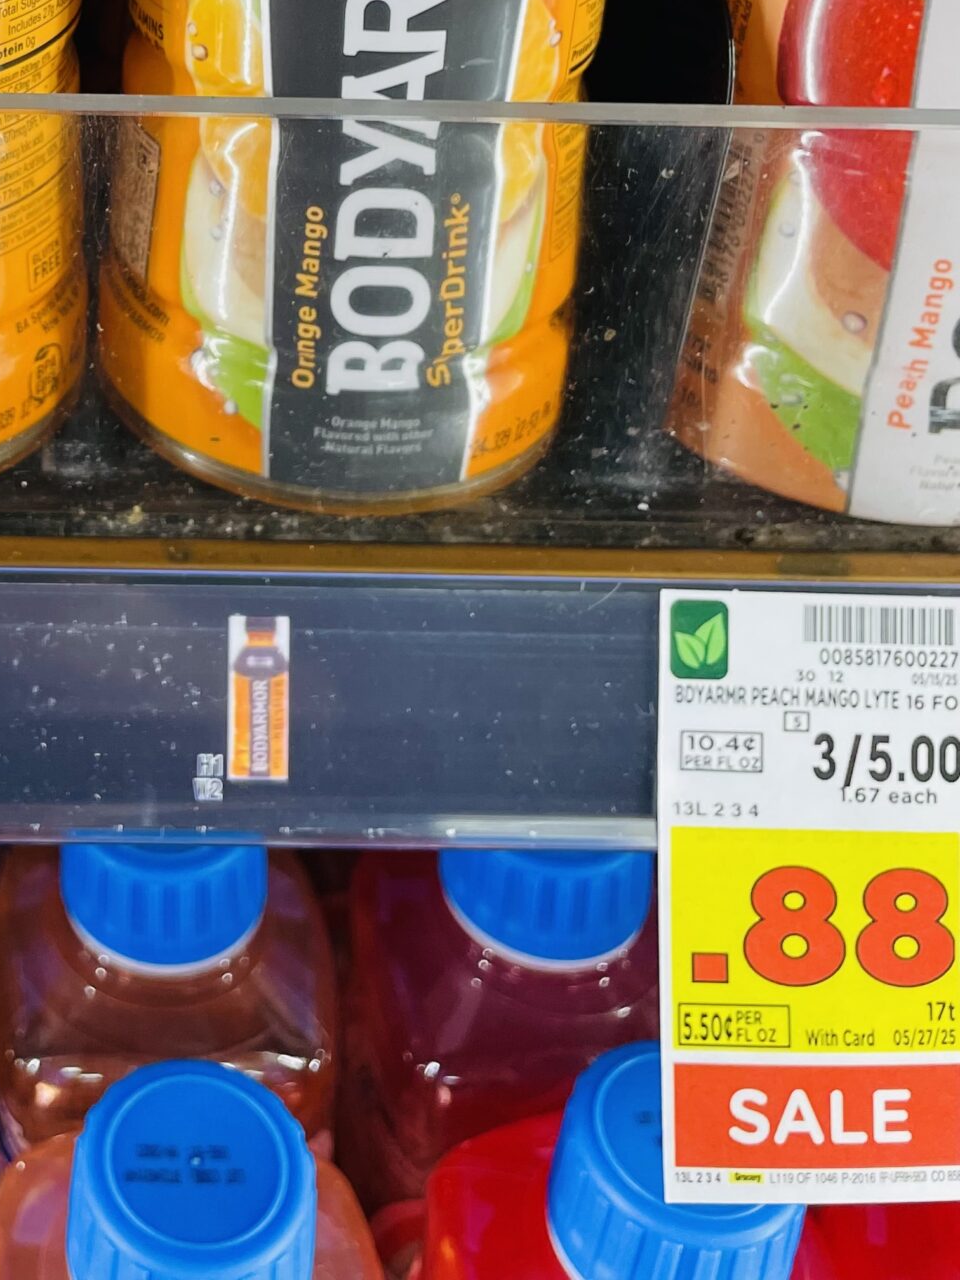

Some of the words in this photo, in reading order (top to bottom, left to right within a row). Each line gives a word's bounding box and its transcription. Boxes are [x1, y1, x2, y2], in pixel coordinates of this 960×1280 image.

[7, 13, 42, 36] Includes
[295, 204, 328, 298] Mango
[908, 257, 955, 350] Mango
[820, 648, 959, 669] 0085817600227
[796, 670, 815, 682] 30
[829, 670, 844, 683] 12
[675, 684, 747, 705] BDYARMR
[751, 686, 800, 706] PEACH
[805, 688, 860, 708] MANGO
[865, 690, 900, 709] LYTE
[907, 695, 925, 710] 16
[932, 695, 959, 710] FO
[688, 734, 756, 752] 10.4¢
[685, 755, 712, 768] PER
[717, 756, 733, 769] FL
[740, 757, 760, 770] OZ
[813, 732, 960, 787] 3/5.00
[840, 787, 880, 803] 1.67
[889, 788, 938, 805] each
[673, 802, 706, 816] 13L
[715, 803, 724, 817] 2
[732, 803, 742, 817] 3
[749, 804, 760, 817] 4
[692, 865, 956, 988] .88
[926, 1001, 956, 1021] 17t
[683, 1012, 733, 1041] 5.50¢
[736, 1011, 762, 1025] PER
[736, 1028, 752, 1042] FL
[758, 1028, 777, 1042] OZ
[807, 1029, 840, 1047] With
[842, 1029, 876, 1047] Card
[893, 1029, 957, 1046] 05/27/25
[728, 1087, 913, 1146] SALE
